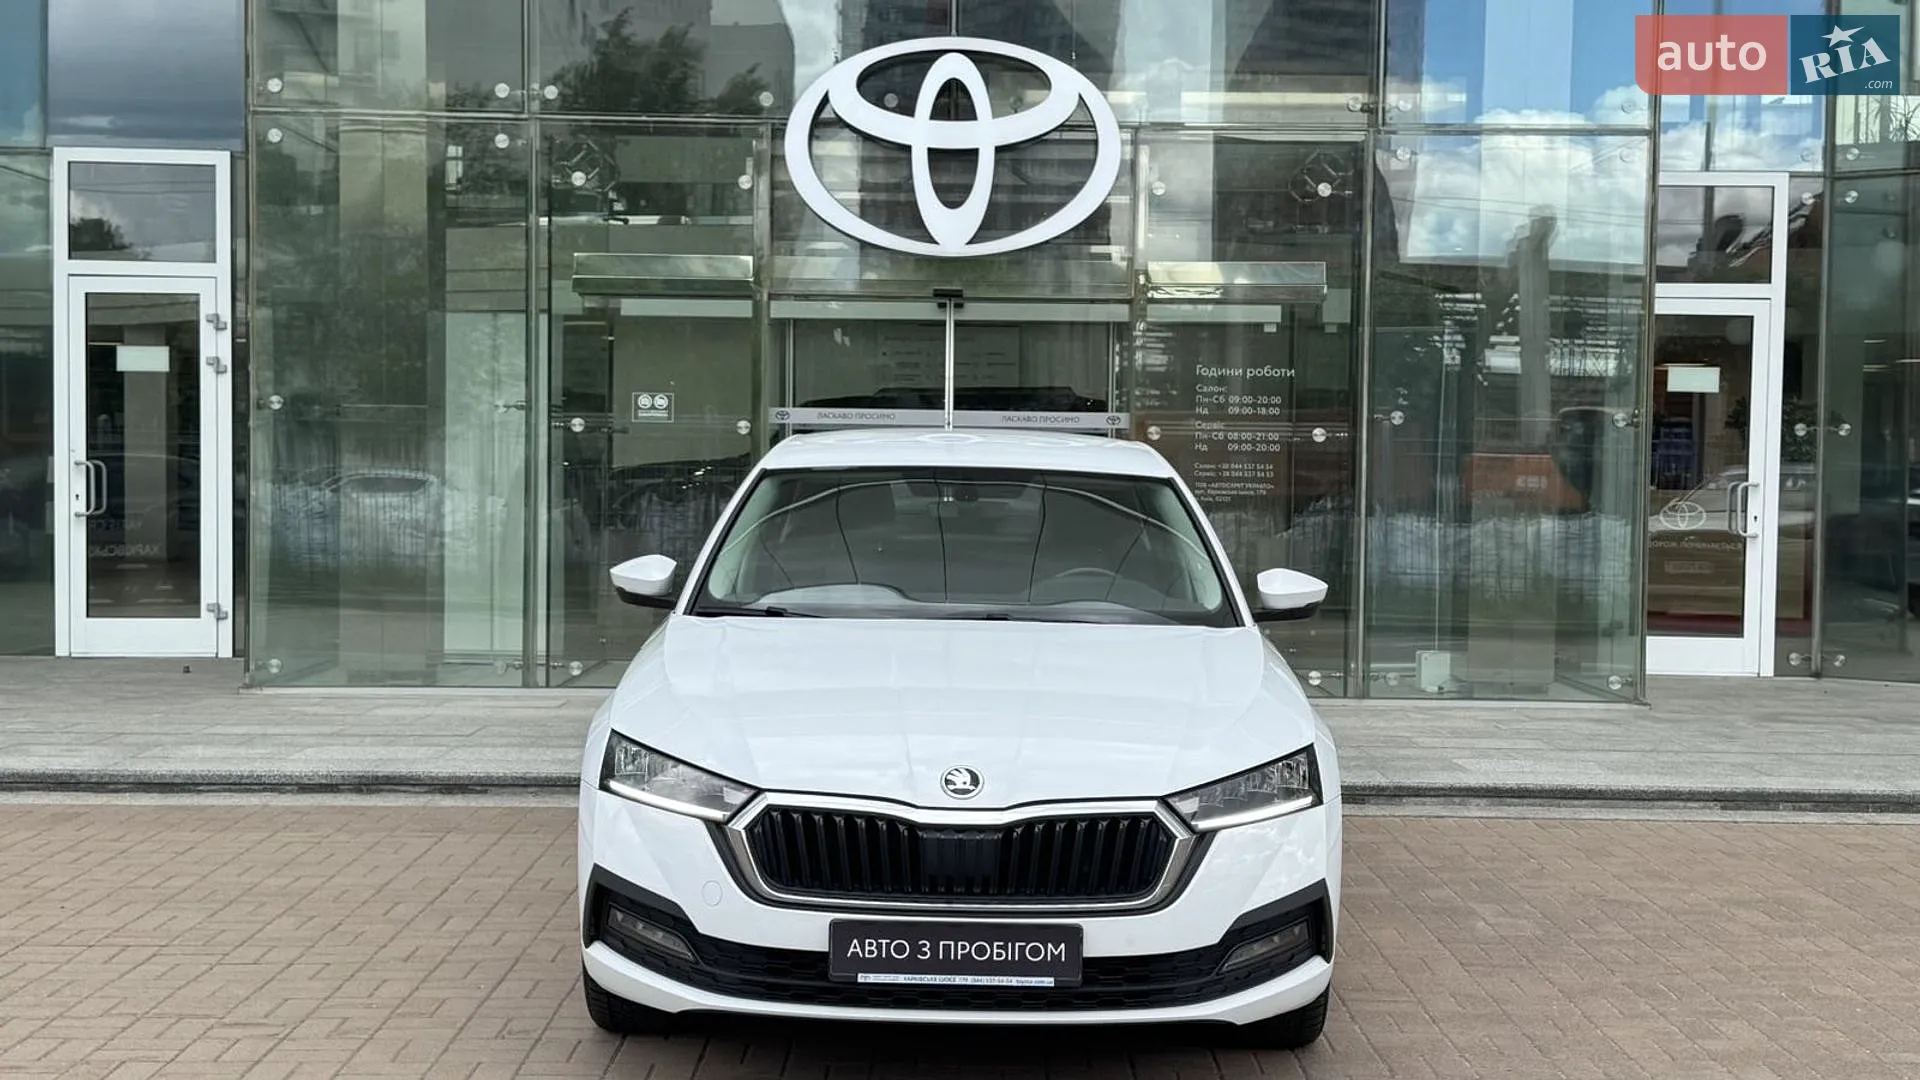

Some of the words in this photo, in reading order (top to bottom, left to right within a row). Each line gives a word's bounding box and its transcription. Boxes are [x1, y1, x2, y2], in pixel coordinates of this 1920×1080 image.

[1196, 364, 1243, 377] Години
[1246, 364, 1296, 379] роботи
[1195, 395, 1225, 404] Пн-Сб
[1228, 395, 1282, 405] 09:00-20:00
[1195, 406, 1209, 415] Нд
[1227, 406, 1281, 415] 09:00-18:00
[1001, 415, 1038, 423] ЛАСКАВО
[1039, 415, 1080, 424] ПРОСИМО
[1227, 432, 1280, 441] 08:00-21:00
[1194, 443, 1208, 452] Нд
[1227, 443, 1281, 452] 09:00-20:00
[846, 938, 910, 960] АВТО
[916, 940, 931, 960] З
[938, 940, 1066, 963] ПРОБІГОМ
